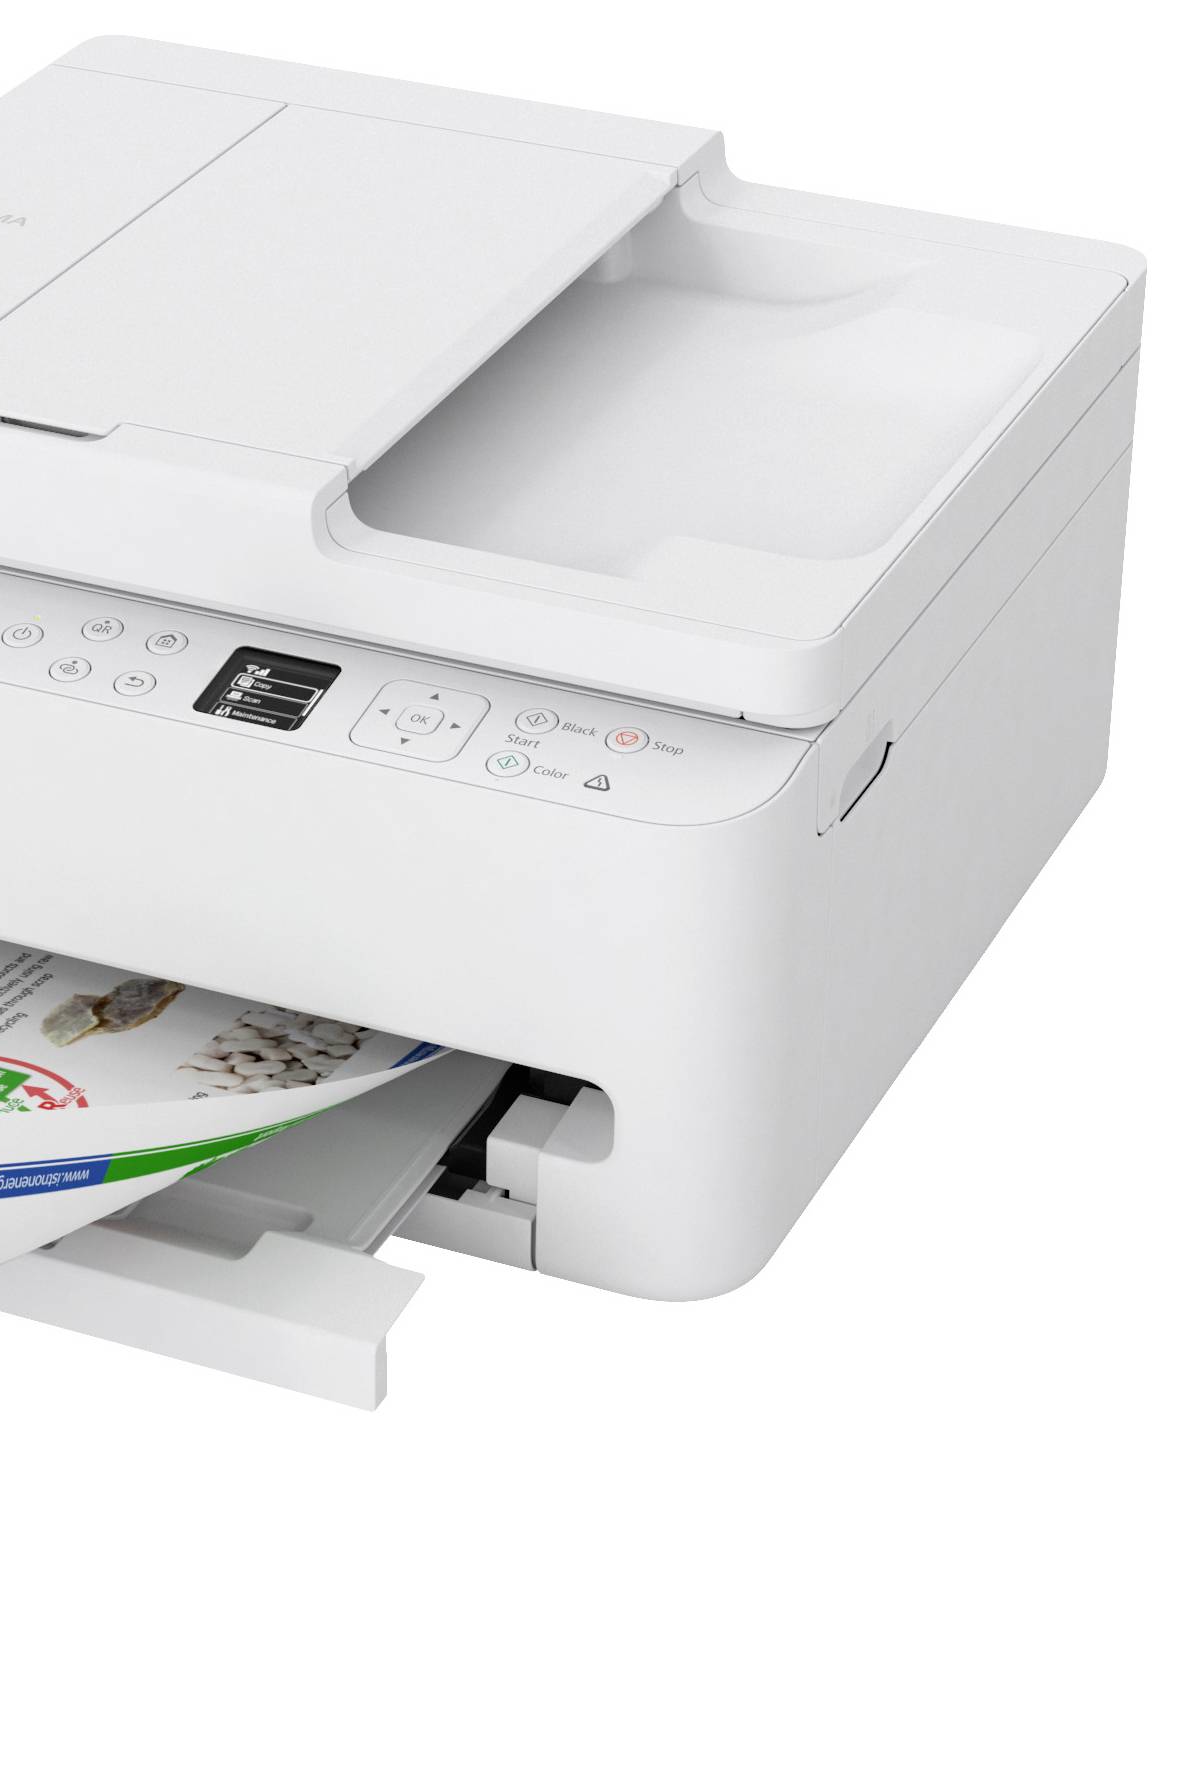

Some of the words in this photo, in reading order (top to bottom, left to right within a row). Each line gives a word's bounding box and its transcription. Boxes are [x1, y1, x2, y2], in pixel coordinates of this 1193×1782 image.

[91, 622, 112, 634] QR
[253, 681, 273, 690] Copy
[242, 695, 262, 704] Scan
[231, 709, 277, 724] Maintenance
[410, 712, 431, 726] OK
[561, 720, 598, 737] Black
[505, 733, 541, 749] Start
[653, 740, 684, 757] Stop
[533, 764, 569, 781] Color
[15, 952, 32, 964] and
[20, 963, 44, 979] using
[38, 954, 54, 965] raw
[3, 987, 34, 1008] through
[32, 972, 54, 988] scrap
